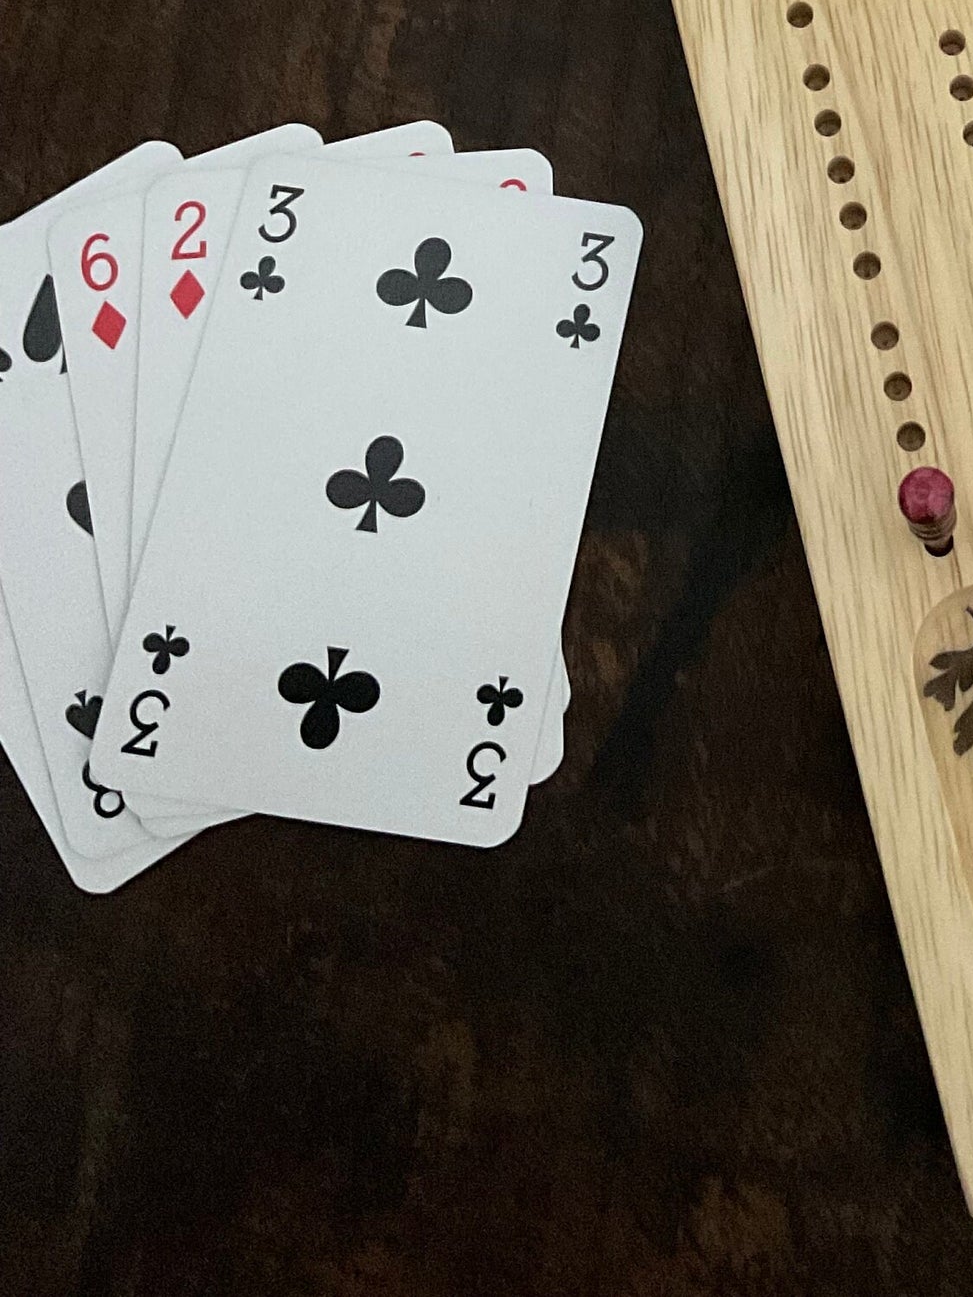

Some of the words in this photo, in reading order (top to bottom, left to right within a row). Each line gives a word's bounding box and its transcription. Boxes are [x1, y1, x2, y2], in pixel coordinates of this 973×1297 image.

[171, 200, 207, 261] 2
[258, 184, 305, 244] 3
[80, 233, 119, 292] 6
[571, 232, 616, 292] 3
[120, 689, 171, 758] 3
[459, 740, 507, 810] 3
